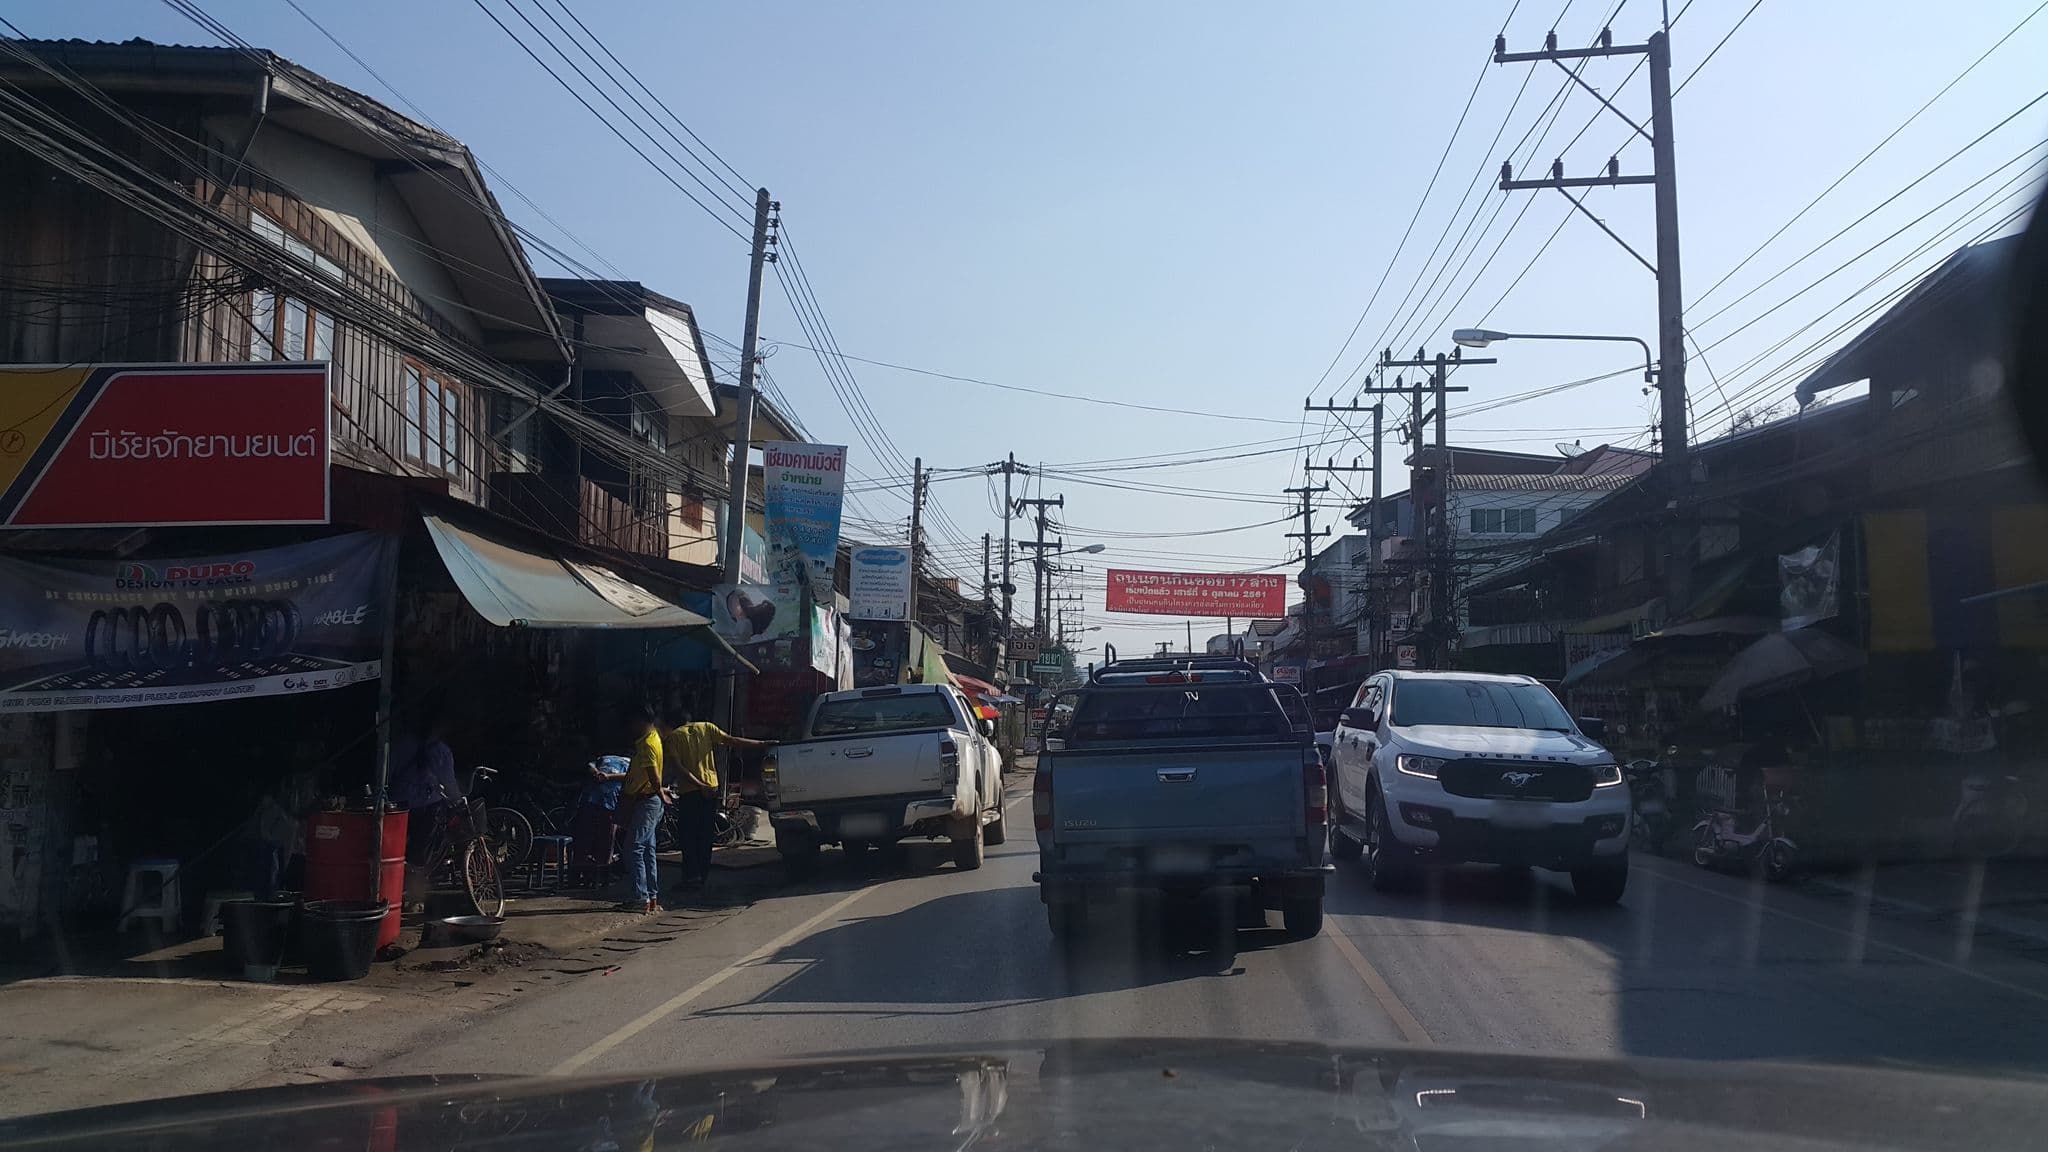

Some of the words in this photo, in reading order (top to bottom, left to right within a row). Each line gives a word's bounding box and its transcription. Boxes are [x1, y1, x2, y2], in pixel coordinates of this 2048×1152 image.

[88, 427, 317, 460] มีชัยจักยานยนต์
[765, 447, 842, 472] เชียงคานบิวตี้
[165, 560, 256, 581] DURO
[115, 578, 173, 589] DESIGN
[224, 585, 257, 597] WITH
[264, 579, 299, 593] DURO
[306, 570, 337, 586] TIRE
[1230, 579, 1247, 587] 17
[1250, 575, 1278, 588] ล่าง
[1211, 589, 1239, 599] ตุลาคม
[1242, 590, 1267, 598] 2561
[1463, 752, 1571, 762] EVEREST
